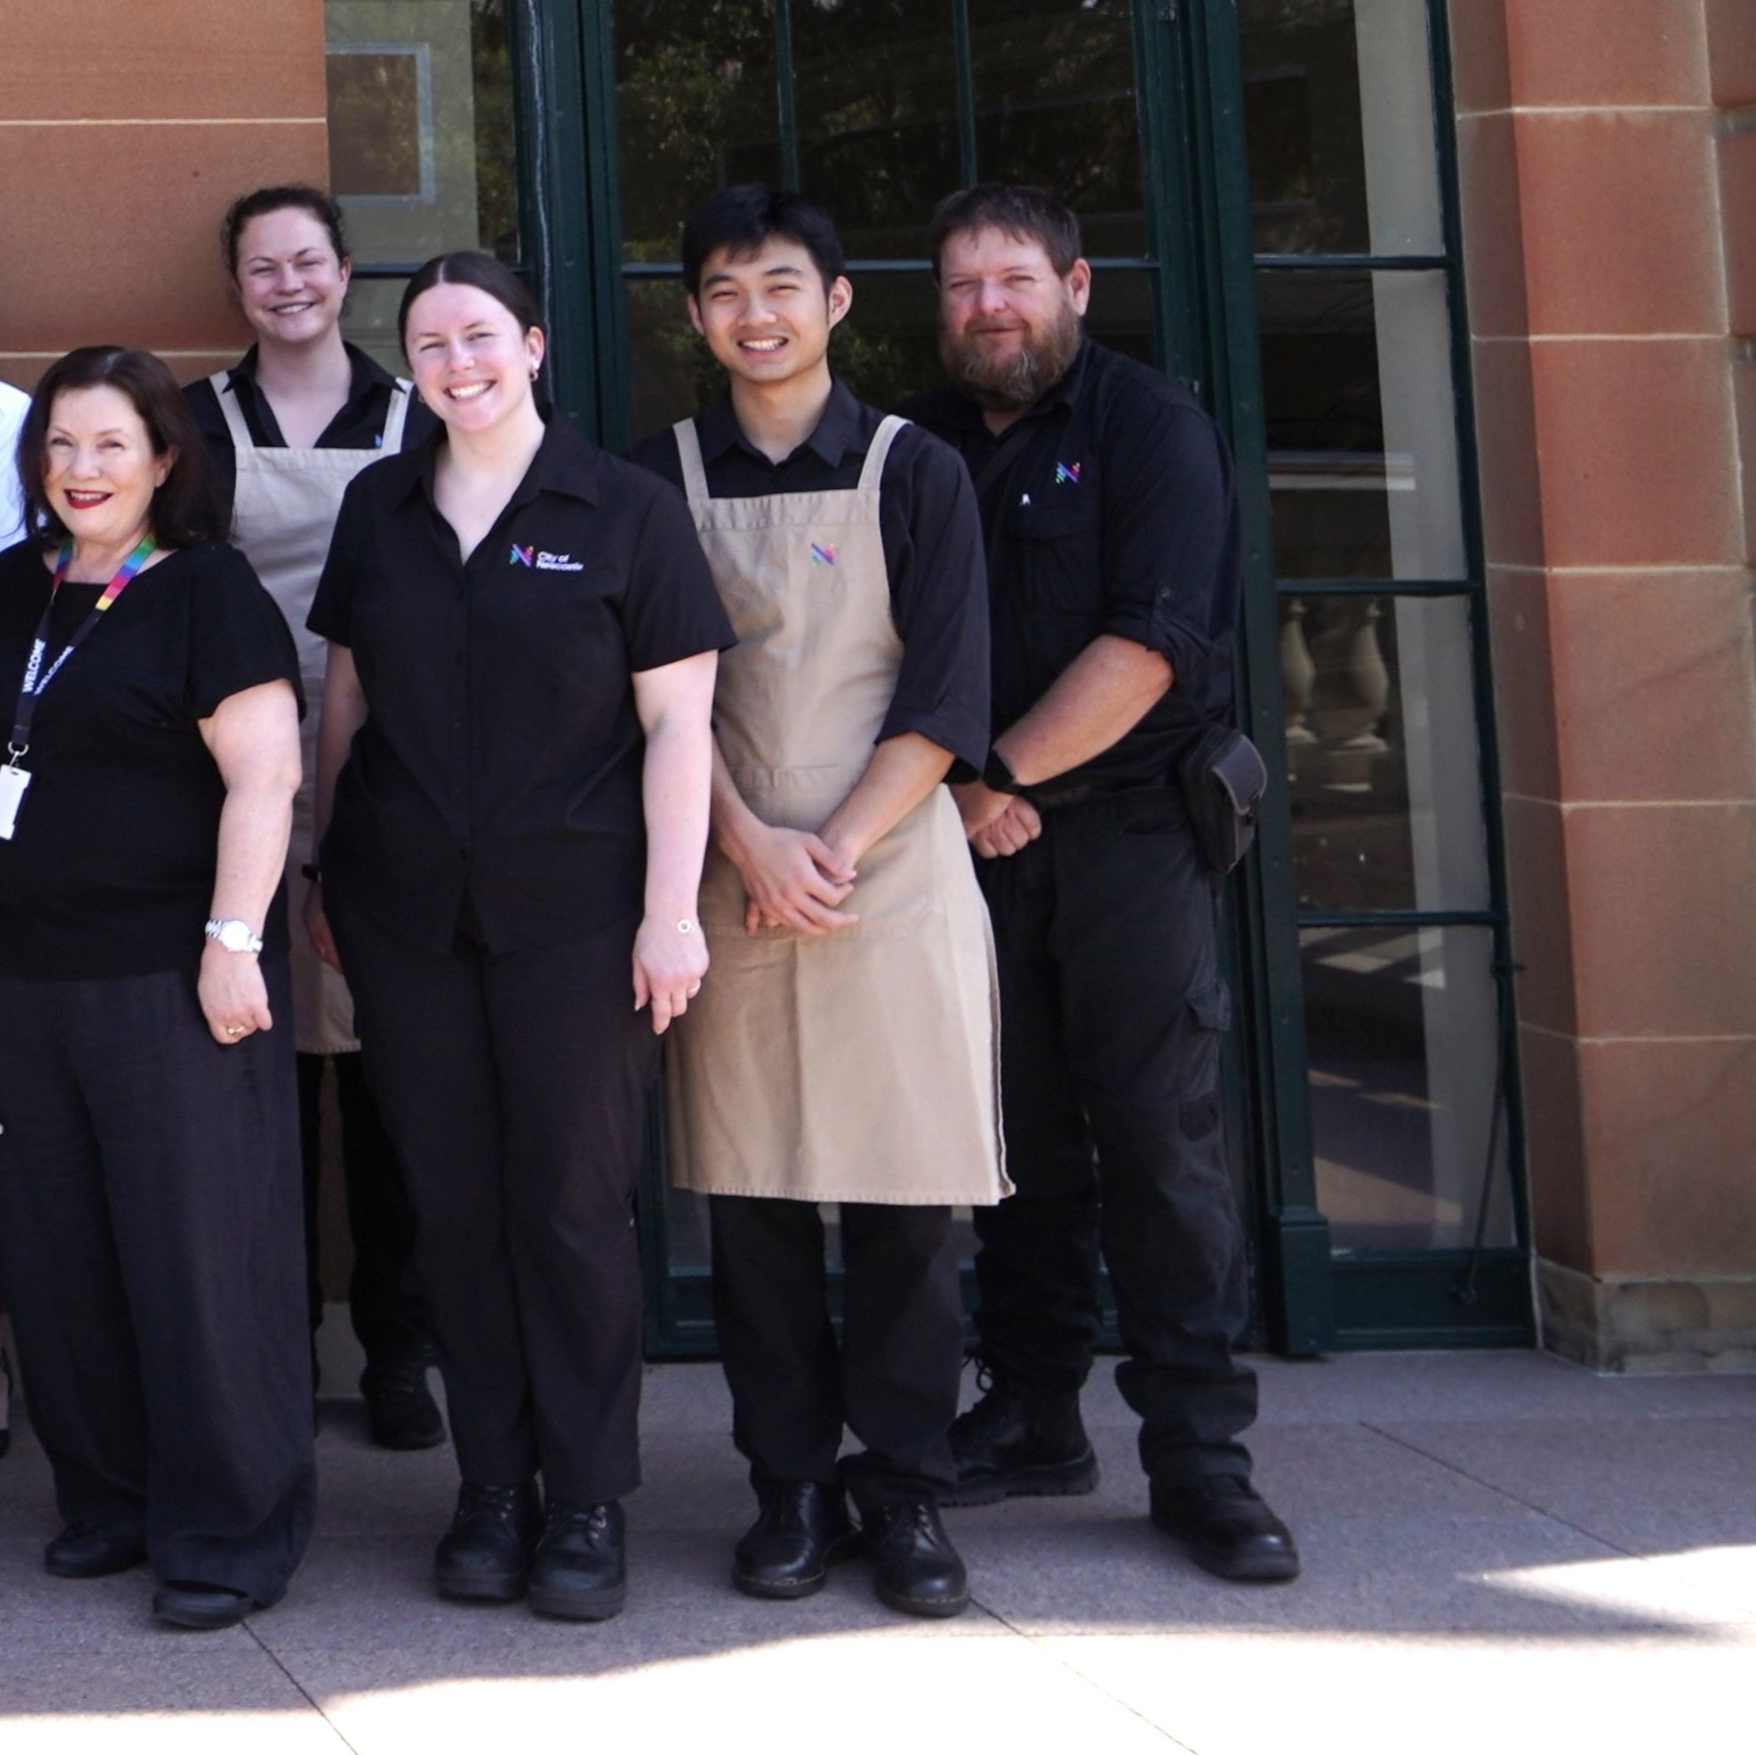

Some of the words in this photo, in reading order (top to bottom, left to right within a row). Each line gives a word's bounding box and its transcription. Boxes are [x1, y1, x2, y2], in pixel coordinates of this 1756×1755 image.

[537, 551, 558, 563] City
[558, 554, 570, 563] of
[535, 560, 584, 571] Newcastle
[21, 637, 46, 693] WELCOME
